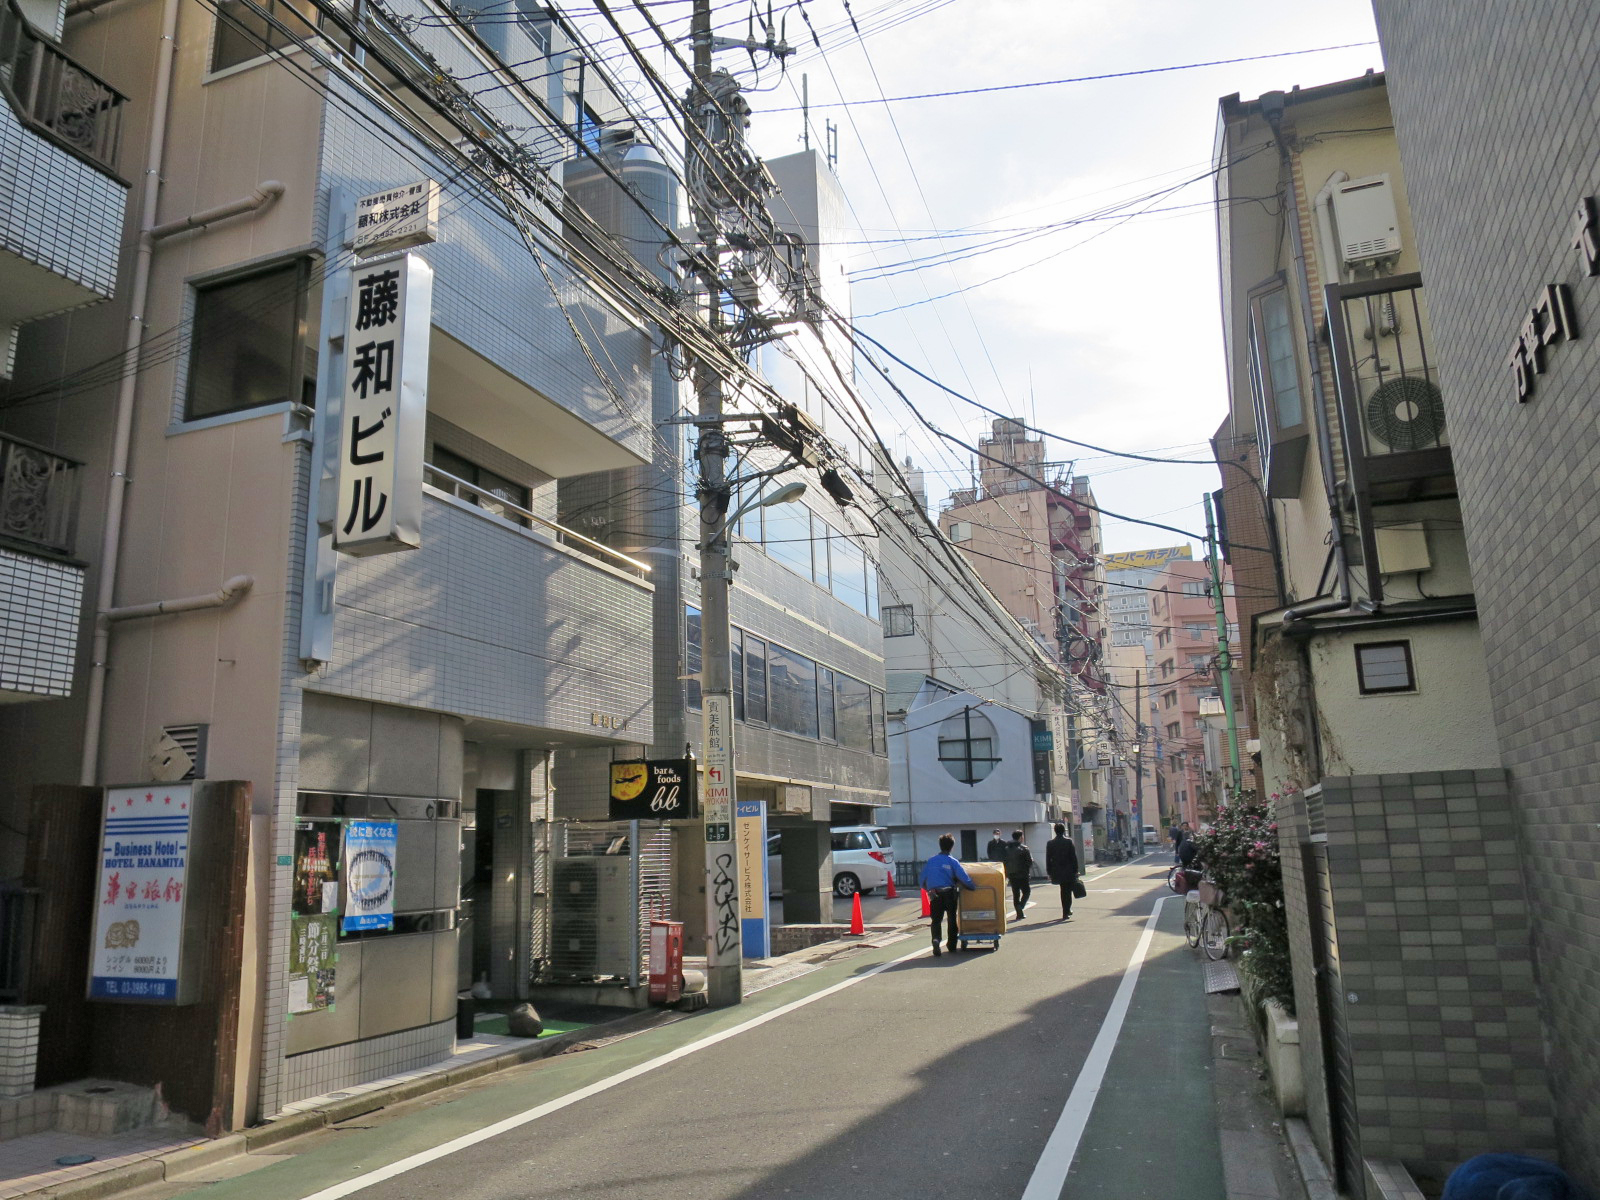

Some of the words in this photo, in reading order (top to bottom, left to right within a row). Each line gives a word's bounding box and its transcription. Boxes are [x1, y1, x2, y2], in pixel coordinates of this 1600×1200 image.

[342, 269, 399, 535] 藤和ビル
[1105, 548, 1180, 564] スーパーホテル
[708, 701, 720, 749] 貴美旅館
[654, 766, 668, 774] bar
[657, 774, 681, 784] foods
[705, 787, 729, 798] KIMI
[114, 841, 152, 857] Business
[155, 840, 178, 856] Hotel
[105, 859, 134, 869] HOTEL
[137, 858, 185, 868] HANAMIYA
[307, 922, 320, 973] 節分祭
[106, 981, 119, 993] TEL
